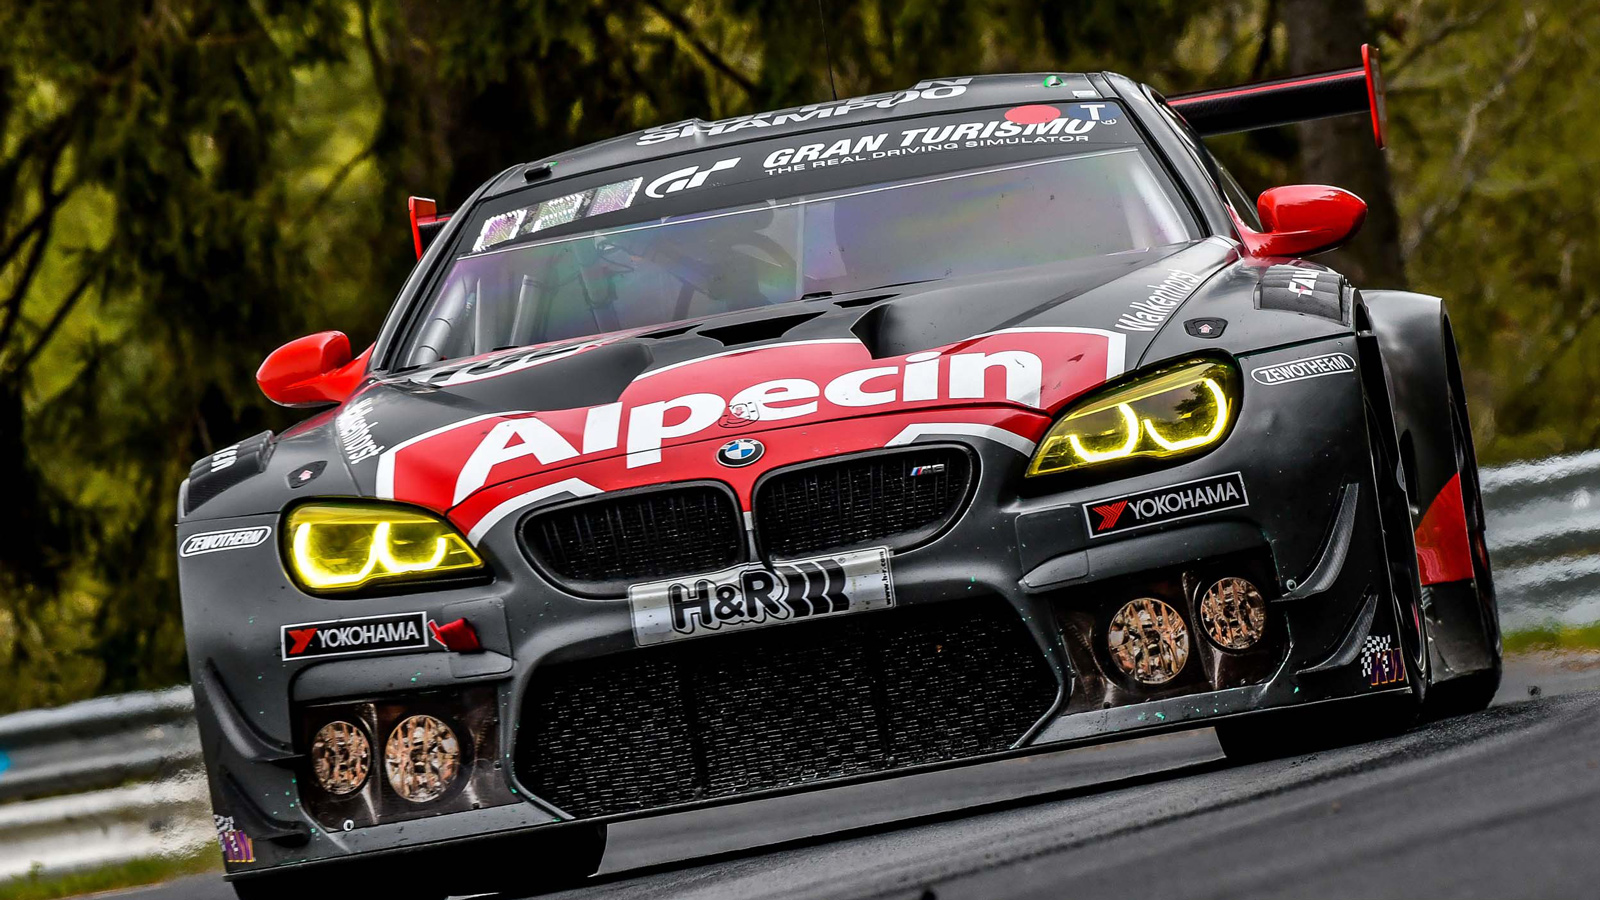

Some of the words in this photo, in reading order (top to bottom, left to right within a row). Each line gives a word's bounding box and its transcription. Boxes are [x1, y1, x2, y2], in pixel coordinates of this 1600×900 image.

[636, 86, 967, 146] SHAMPOO
[763, 133, 889, 169] GRAN
[765, 164, 806, 176] THE
[812, 155, 867, 168] REAL
[872, 141, 958, 159] DRIVING
[965, 134, 1090, 149] SIMULATOR
[1114, 268, 1202, 332] Walkenhorst
[1258, 355, 1352, 383] ZEWOTHERM
[453, 350, 1043, 507] Alpecin
[1128, 481, 1240, 520] YOKOHAMA
[184, 529, 266, 554] ZEWOTHERM
[667, 568, 797, 635] H&R
[316, 620, 420, 648] YOKOHAMA
